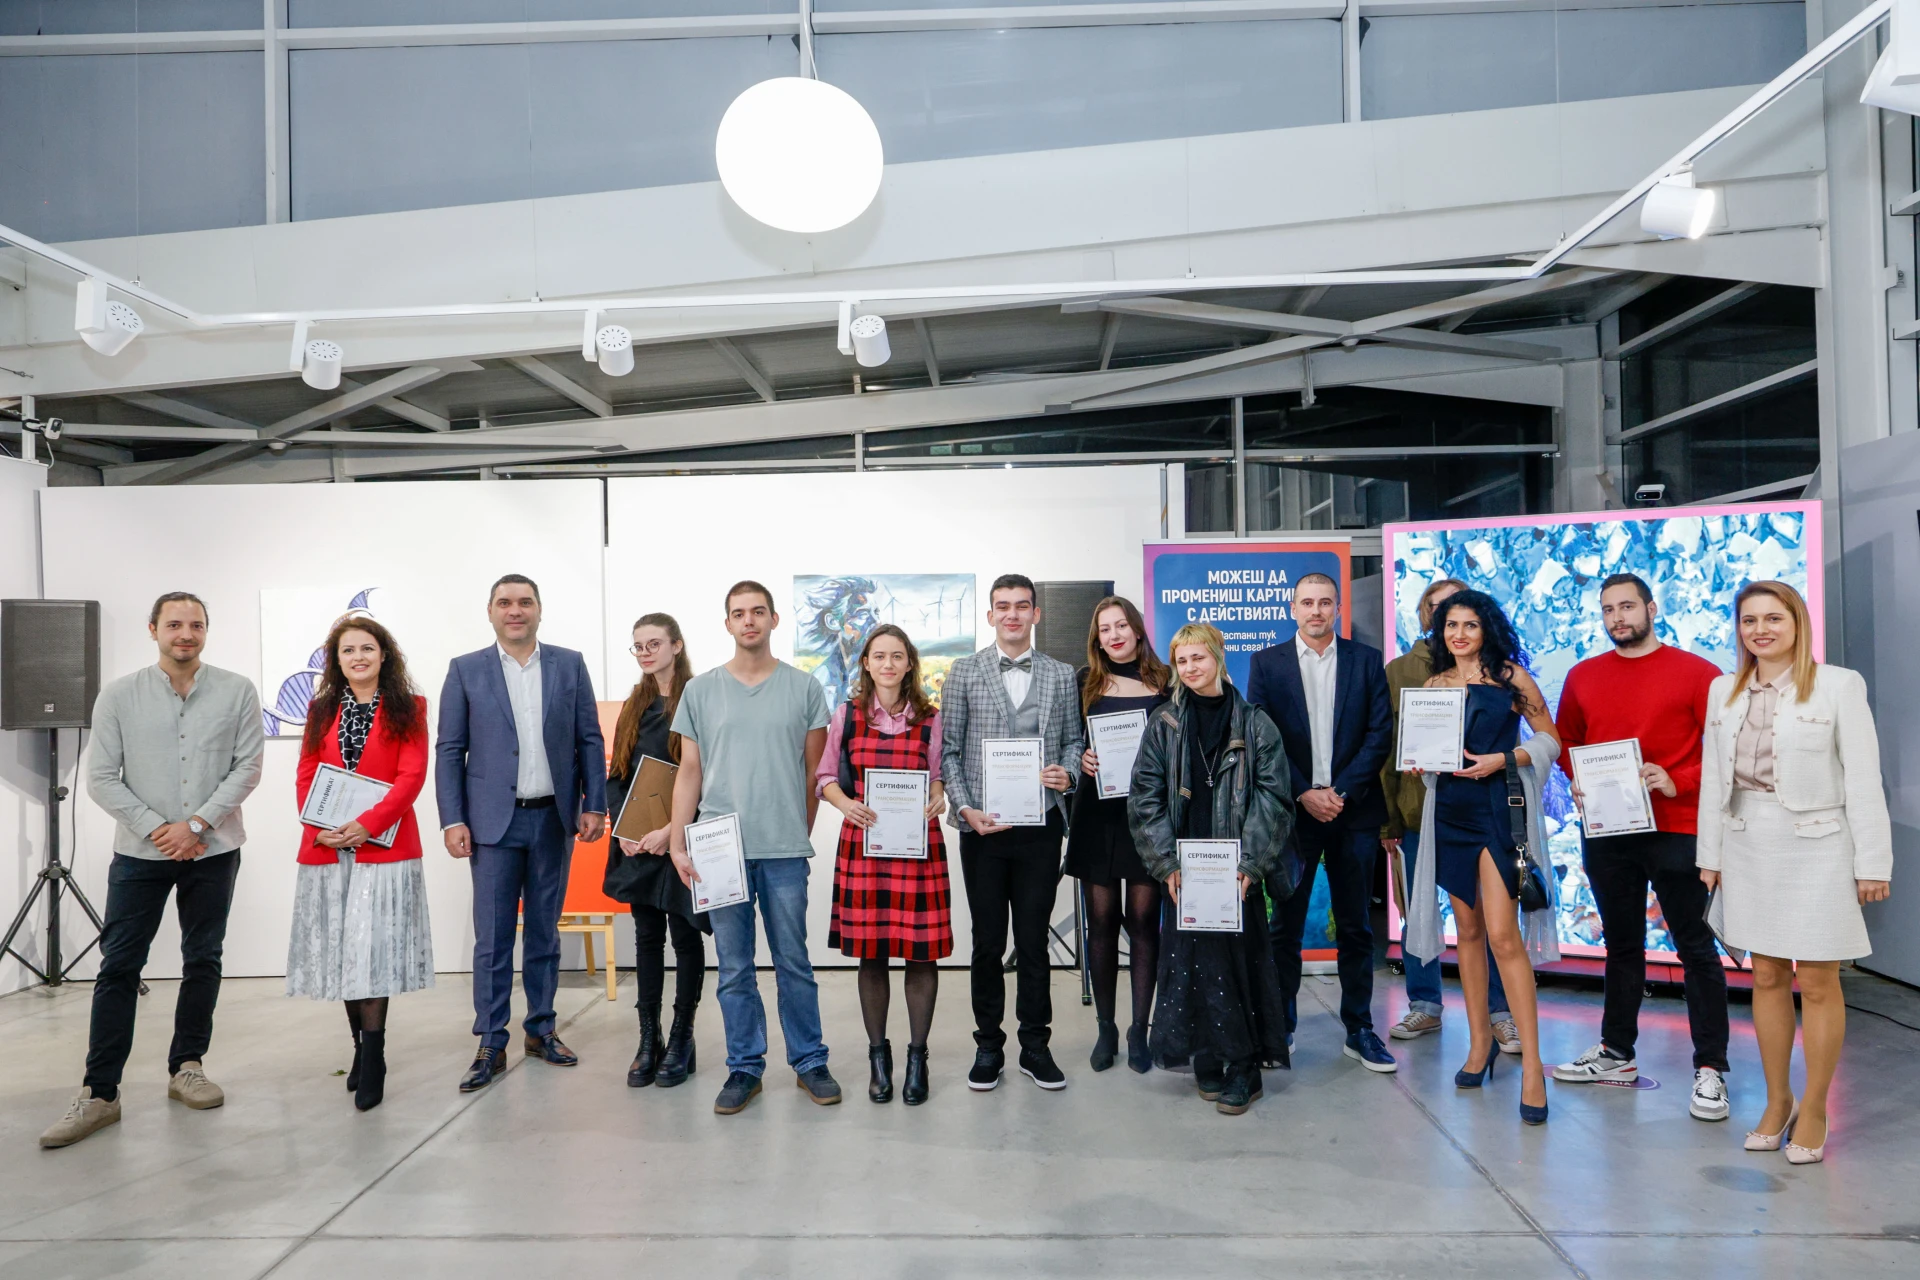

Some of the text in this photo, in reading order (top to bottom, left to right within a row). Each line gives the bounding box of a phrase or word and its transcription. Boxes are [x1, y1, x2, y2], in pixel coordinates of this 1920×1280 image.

[1208, 569, 1288, 586] МОЖЕШ ДА
[1162, 589, 1243, 604] ПРОМЕНИШ
[1187, 607, 1197, 622] С
[1199, 604, 1287, 622] ДЕЙСТВИЯТА
[1258, 629, 1277, 642] тук
[1099, 721, 1138, 733] СЕРТИФИКАТ
[1582, 752, 1628, 765] СЕРТИФИКАТ
[875, 782, 918, 790] СЕРТИФИКАТ
[316, 777, 335, 816] СЕРТИФИКАТ
[695, 828, 731, 842] СЕРТИФИКАТ
[1187, 852, 1231, 860] СЕРТИФИКАТ
